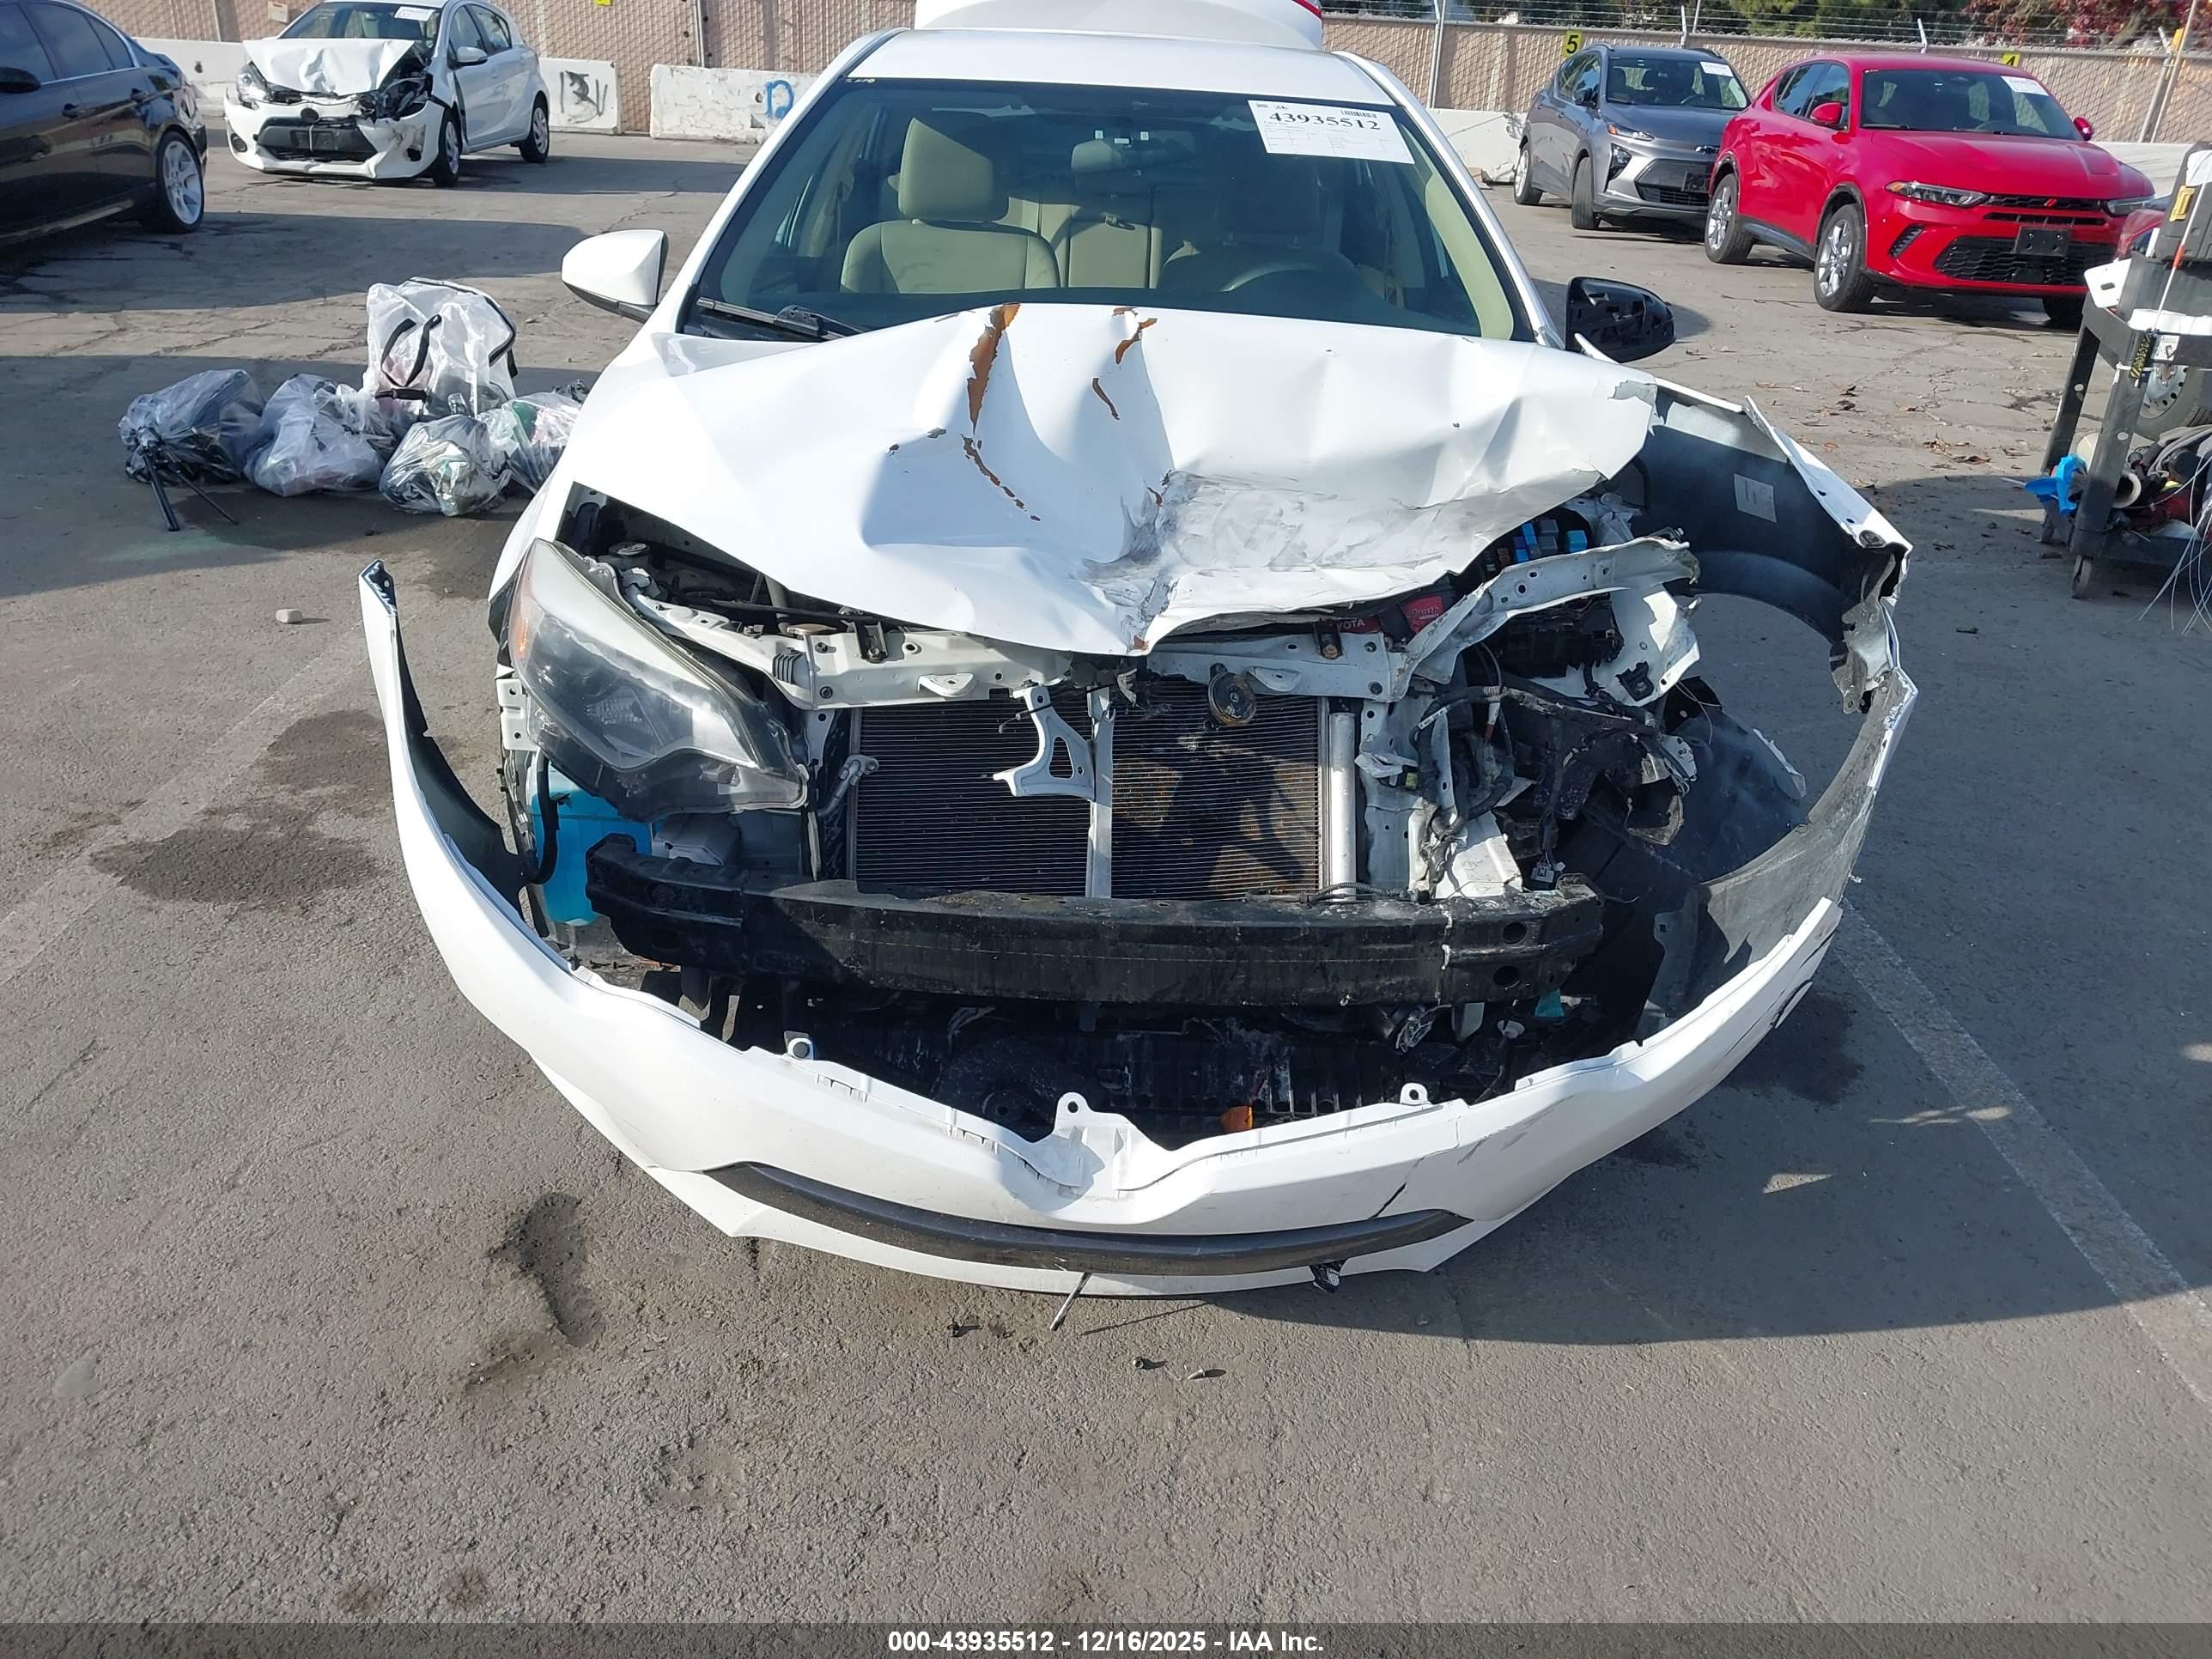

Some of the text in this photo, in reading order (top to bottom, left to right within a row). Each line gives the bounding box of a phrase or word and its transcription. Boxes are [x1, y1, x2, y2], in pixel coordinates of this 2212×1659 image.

[1565, 34, 1579, 54] 5
[1269, 112, 1382, 131] 43935512
[1336, 617, 1366, 630] YOTA
